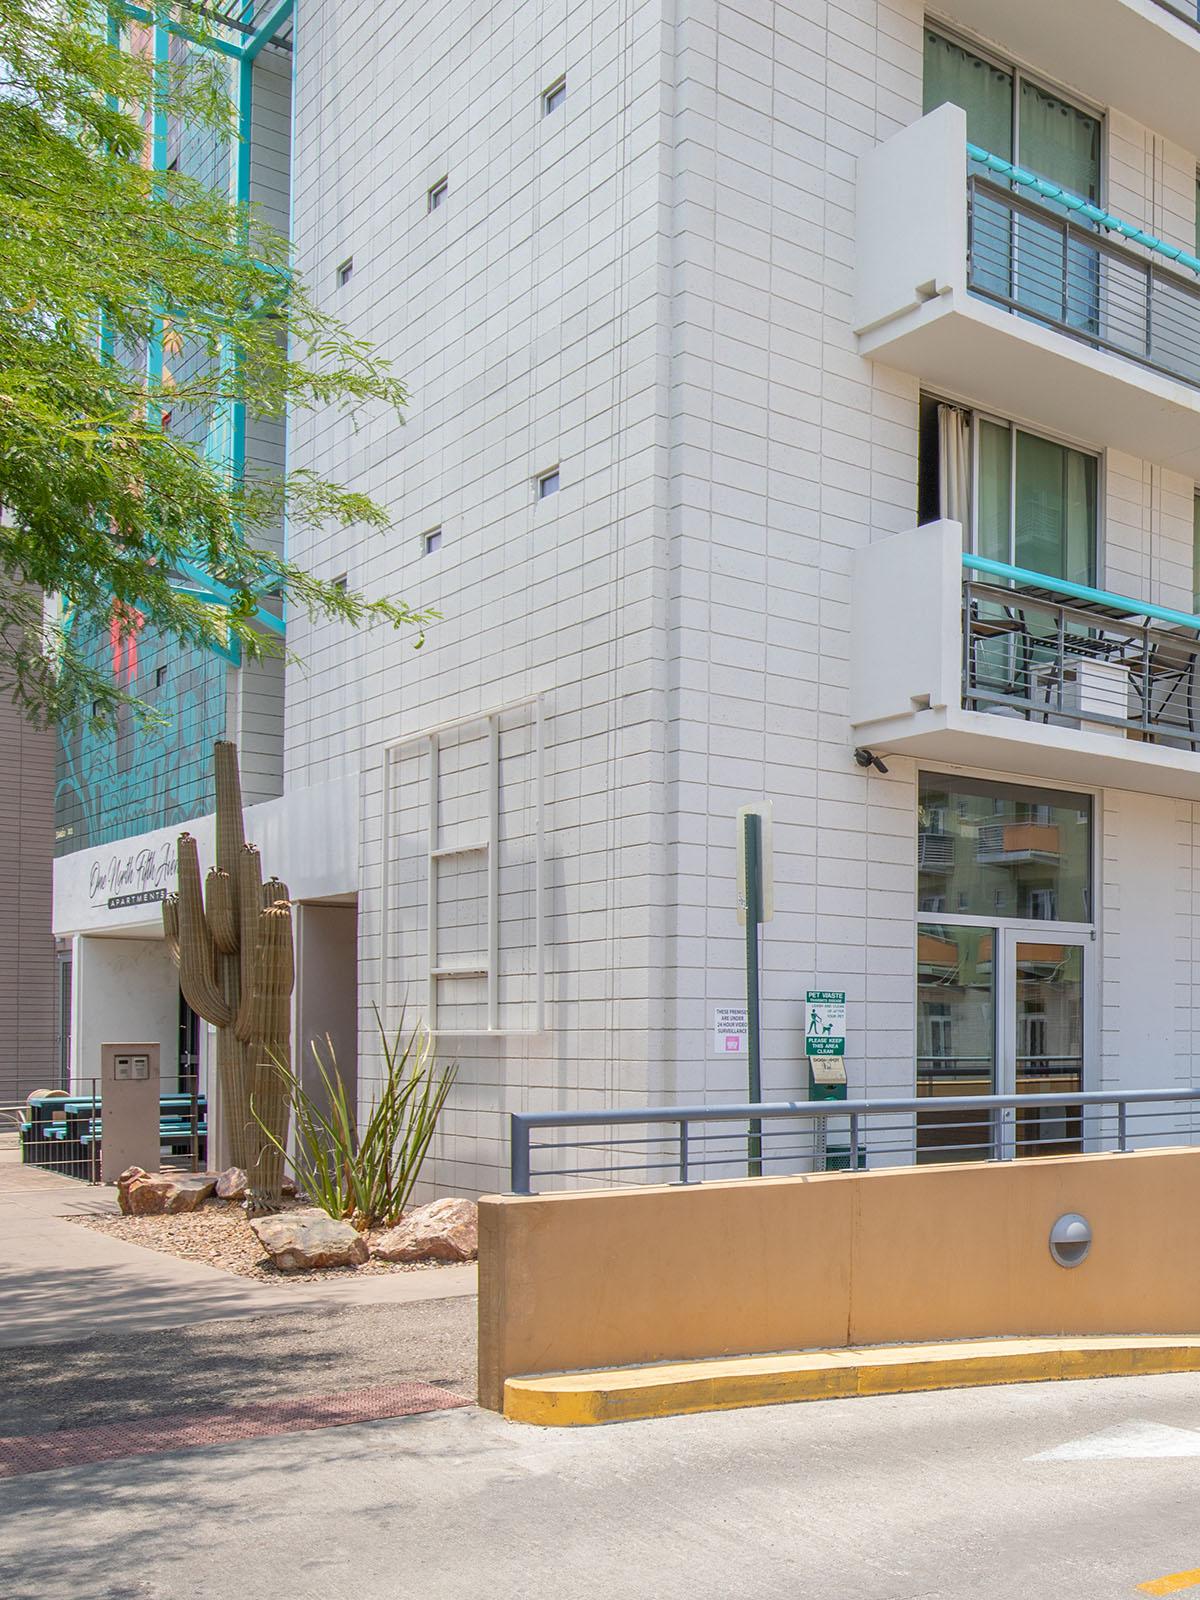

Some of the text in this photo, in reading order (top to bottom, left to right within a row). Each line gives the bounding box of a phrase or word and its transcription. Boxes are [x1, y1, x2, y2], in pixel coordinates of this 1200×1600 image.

[89, 861, 106, 899] One
[108, 855, 134, 896] North
[135, 848, 156, 893] Fifth
[109, 890, 166, 908] APARTMENTS
